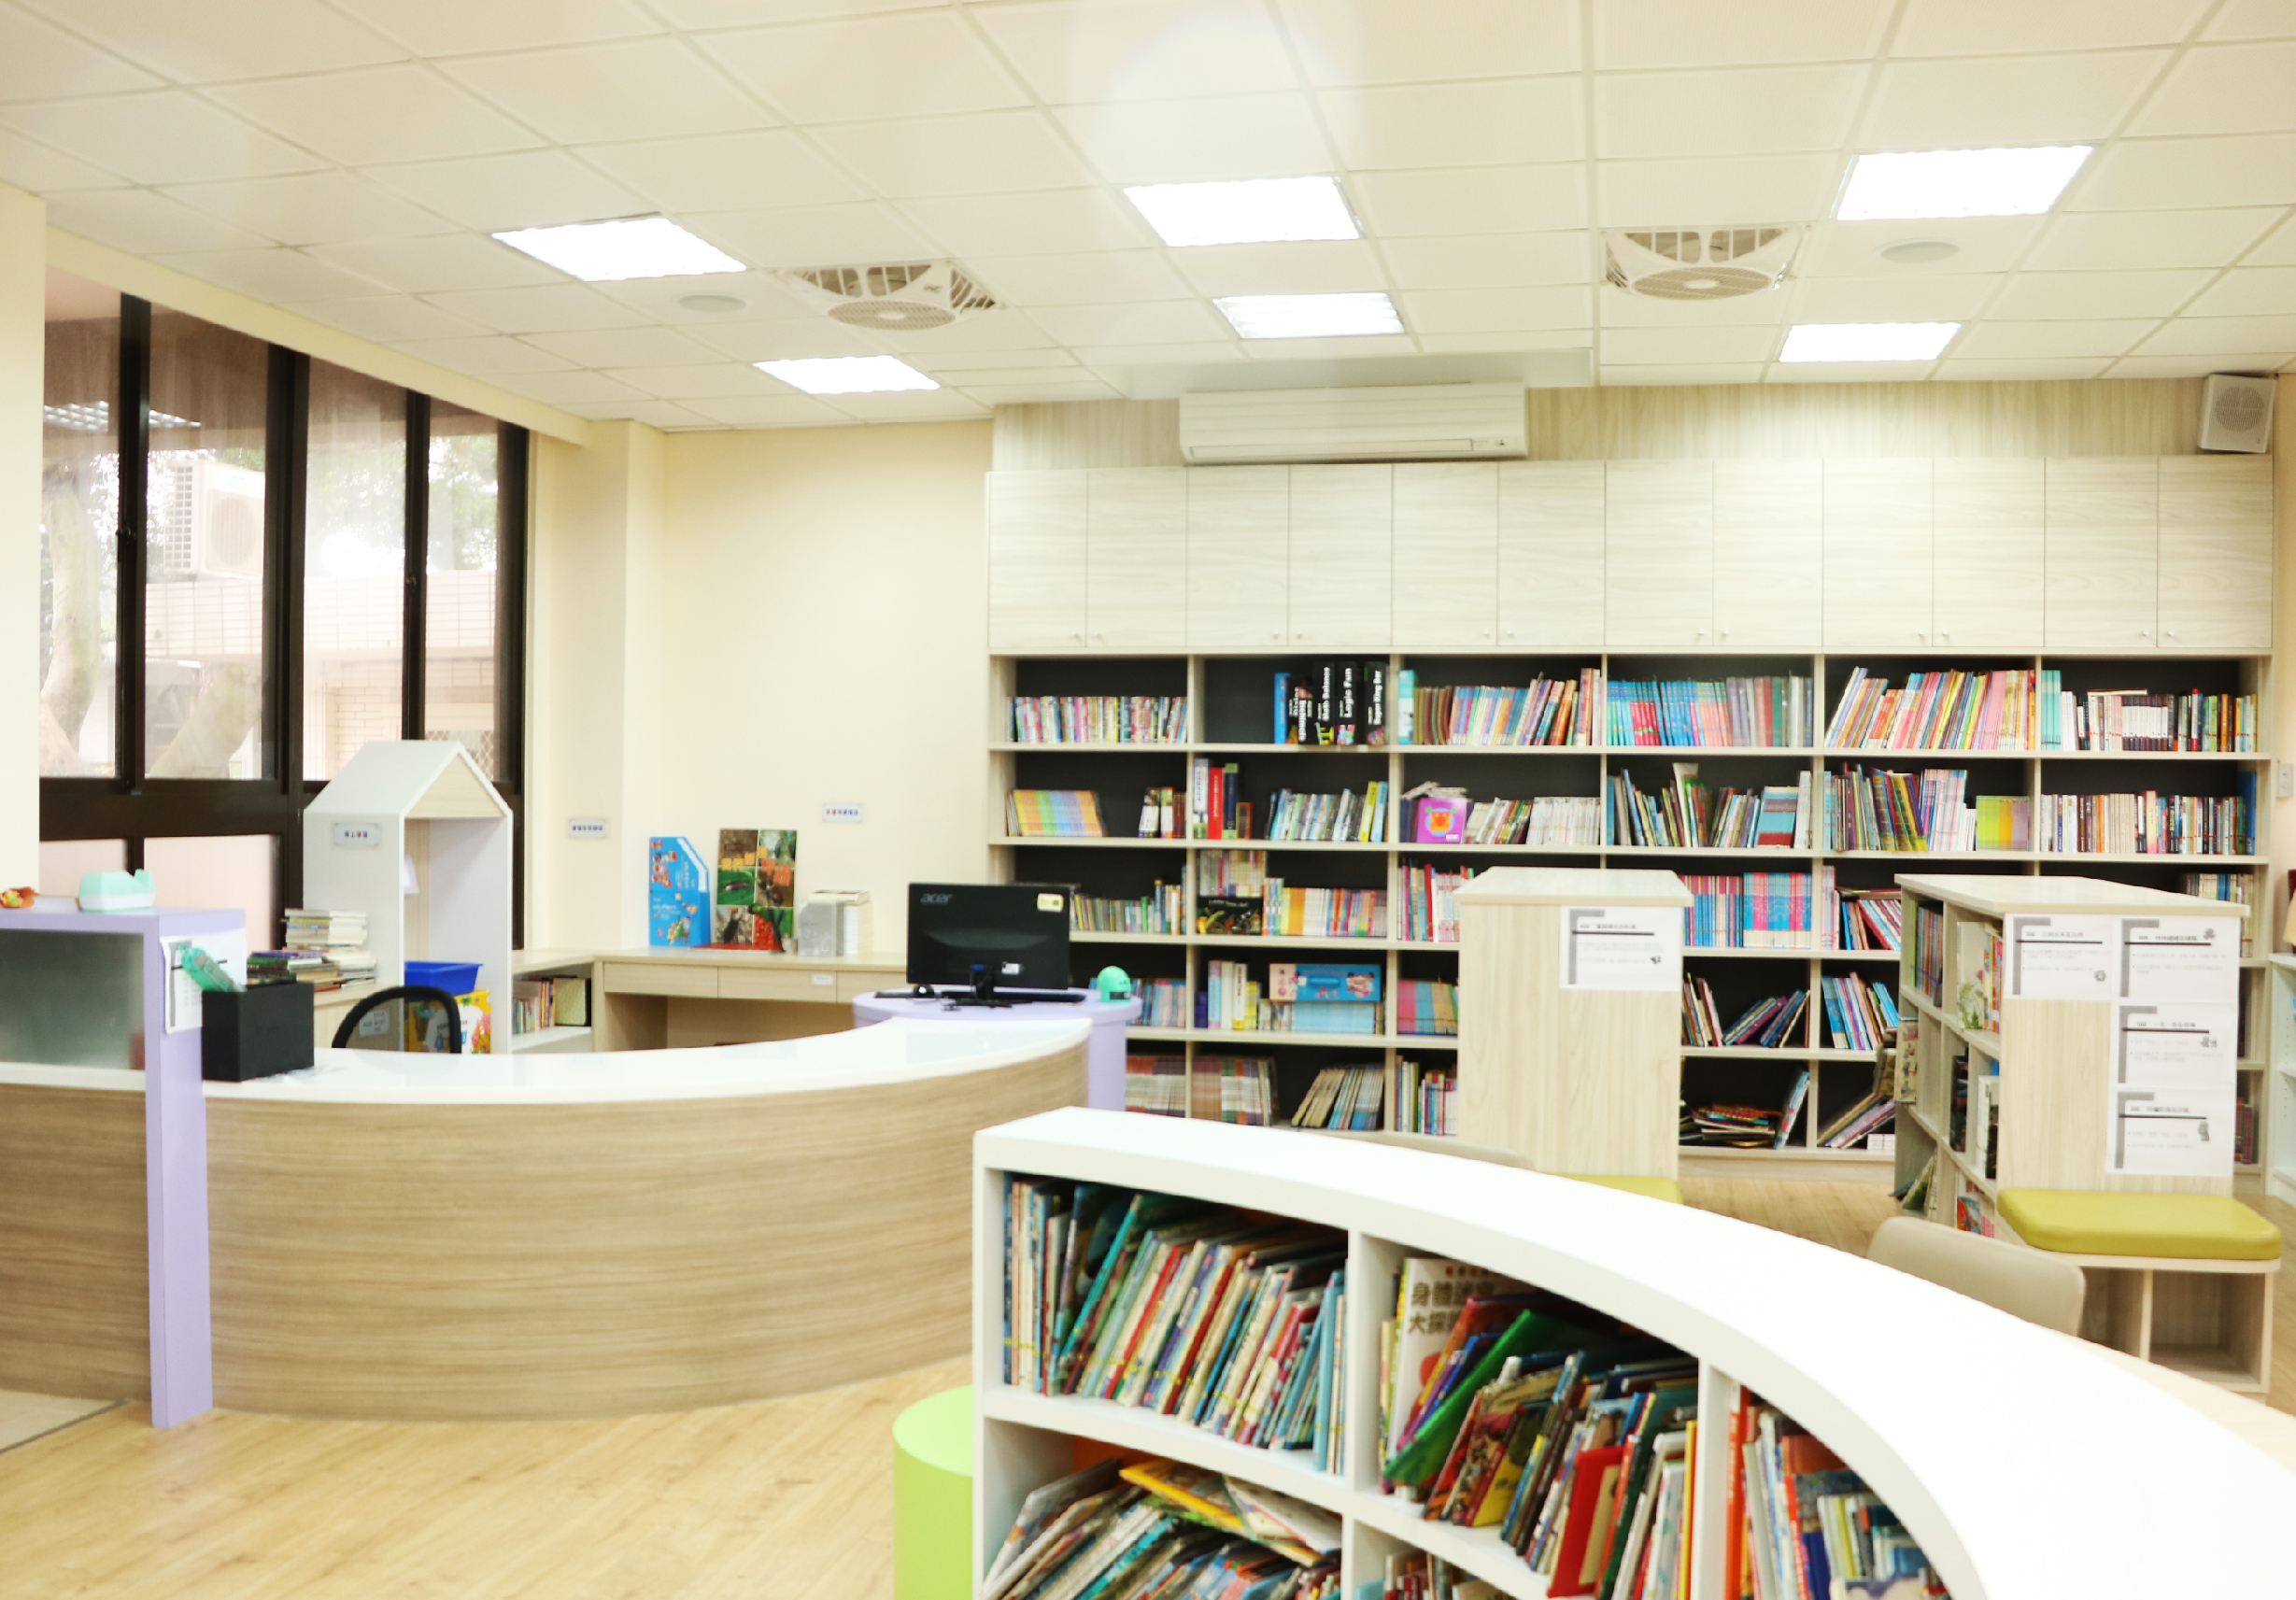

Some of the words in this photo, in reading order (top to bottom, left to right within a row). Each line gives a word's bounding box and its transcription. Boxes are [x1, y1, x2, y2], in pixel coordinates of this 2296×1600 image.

[1322, 667, 1330, 700] Balance
[1343, 668, 1353, 688] Fun
[1322, 701, 1330, 722] Math
[1343, 689, 1354, 718] Logic
[1373, 703, 1382, 725] Super
[920, 892, 953, 904] acer
